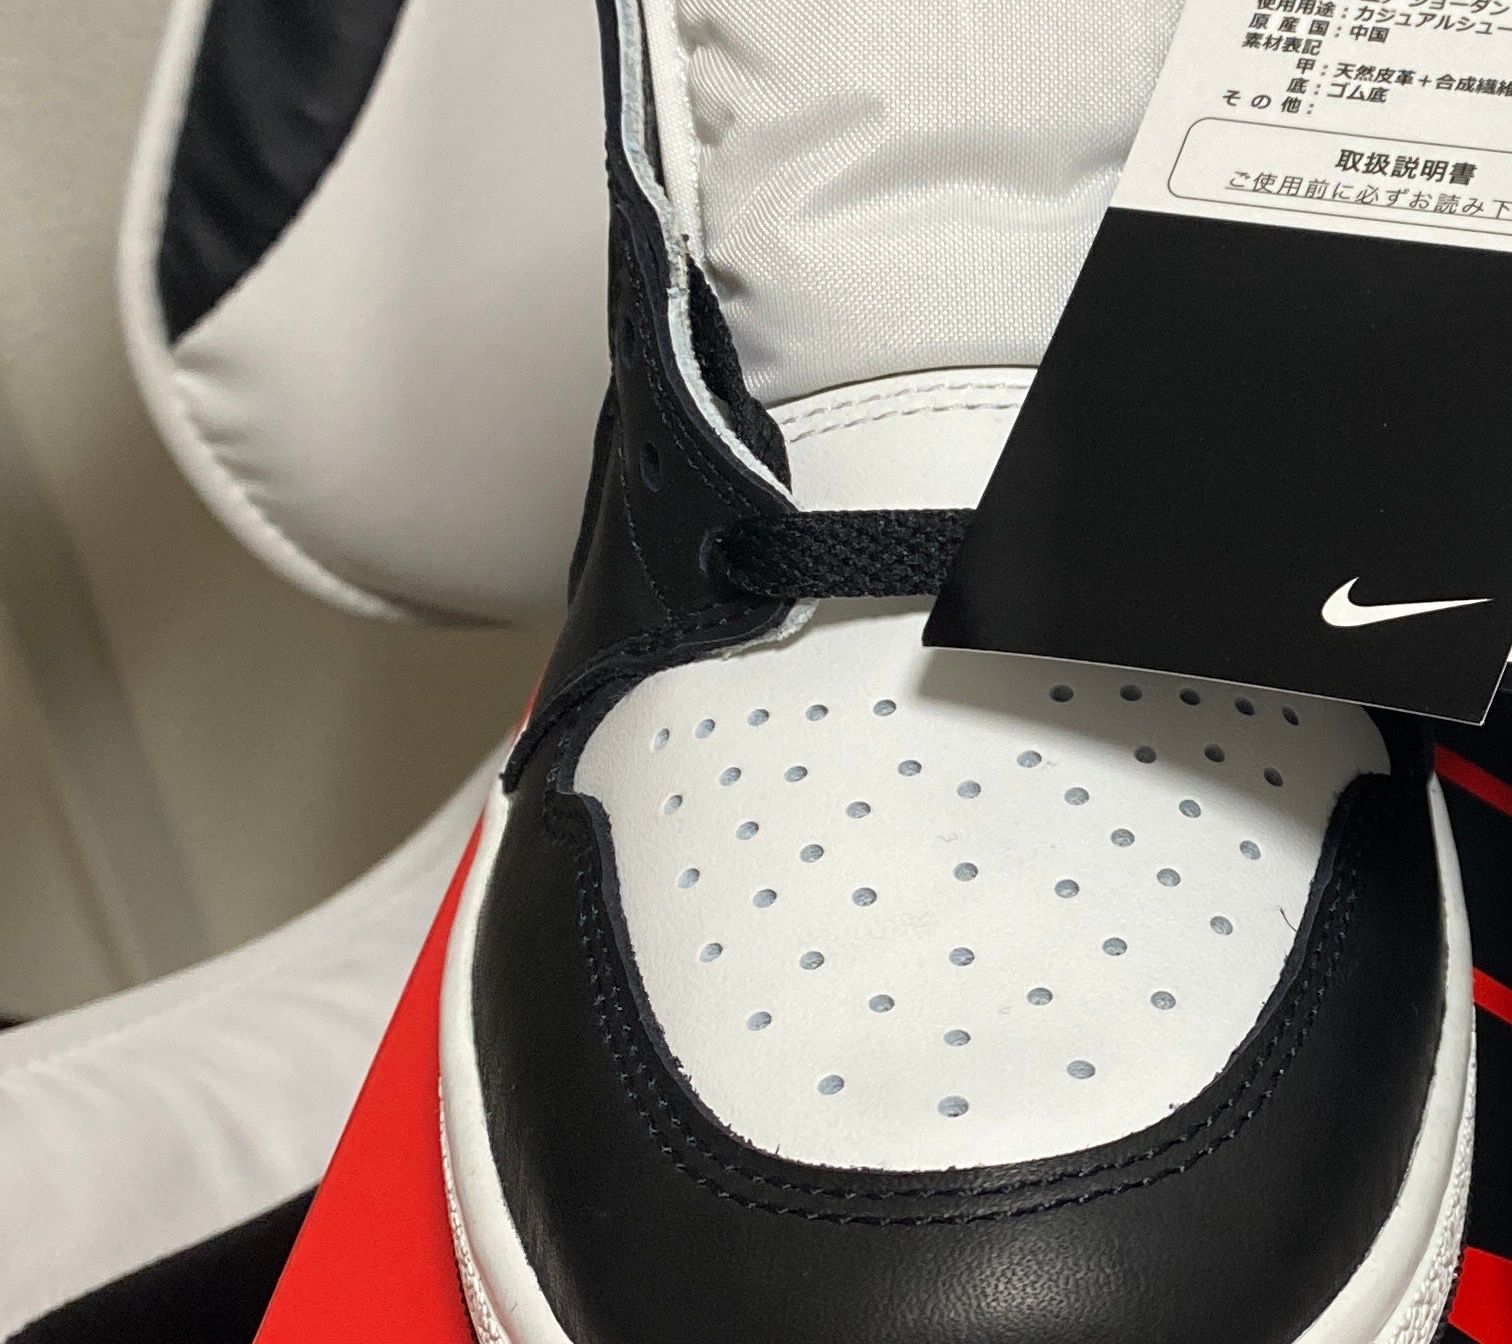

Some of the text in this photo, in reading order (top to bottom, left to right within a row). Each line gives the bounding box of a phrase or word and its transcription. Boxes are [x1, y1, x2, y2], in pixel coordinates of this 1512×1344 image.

[1241, 32, 1323, 56] 素材表記
[1350, 25, 1390, 43] 中国
[1326, 82, 1388, 103] ゴム底
[1334, 149, 1479, 186] 取扱説明書
